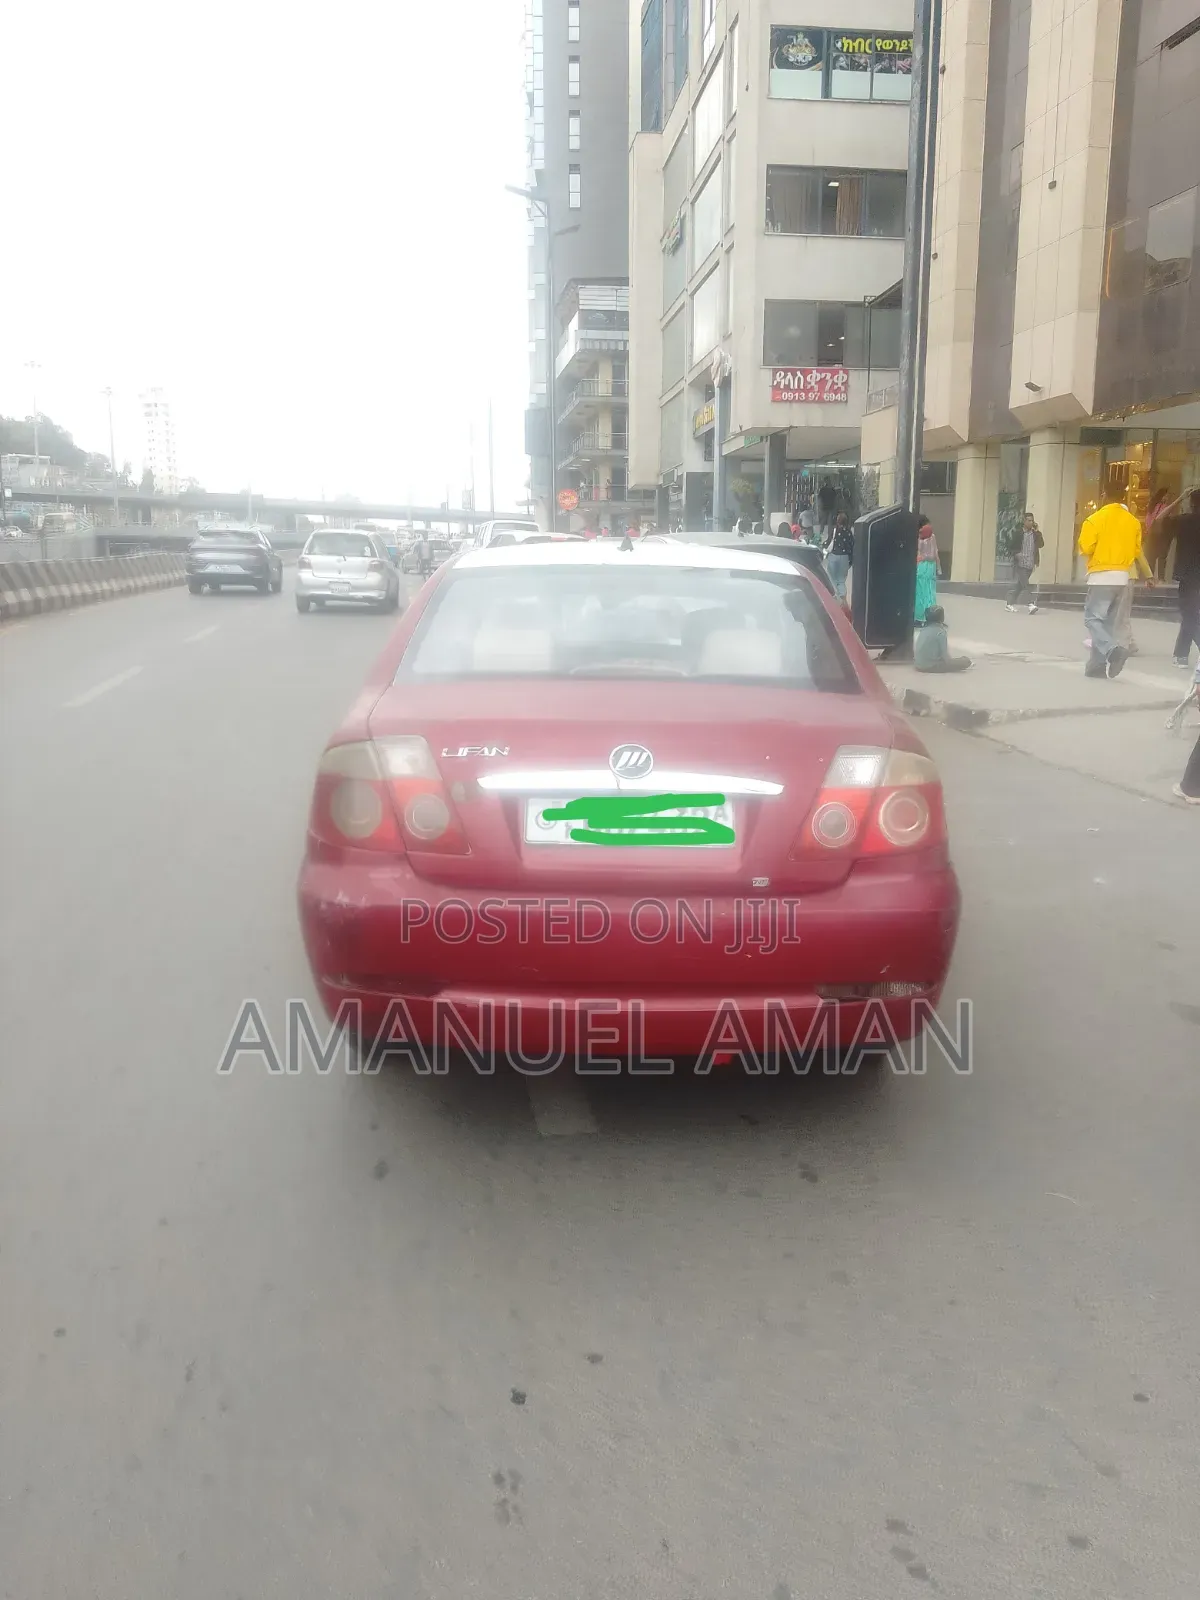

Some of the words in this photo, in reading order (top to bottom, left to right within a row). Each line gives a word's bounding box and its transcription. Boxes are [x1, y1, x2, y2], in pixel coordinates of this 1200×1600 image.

[782, 392, 806, 401] 0913
[808, 392, 820, 401] 97
[823, 392, 847, 402] 6948
[440, 746, 510, 758] LIFAN
